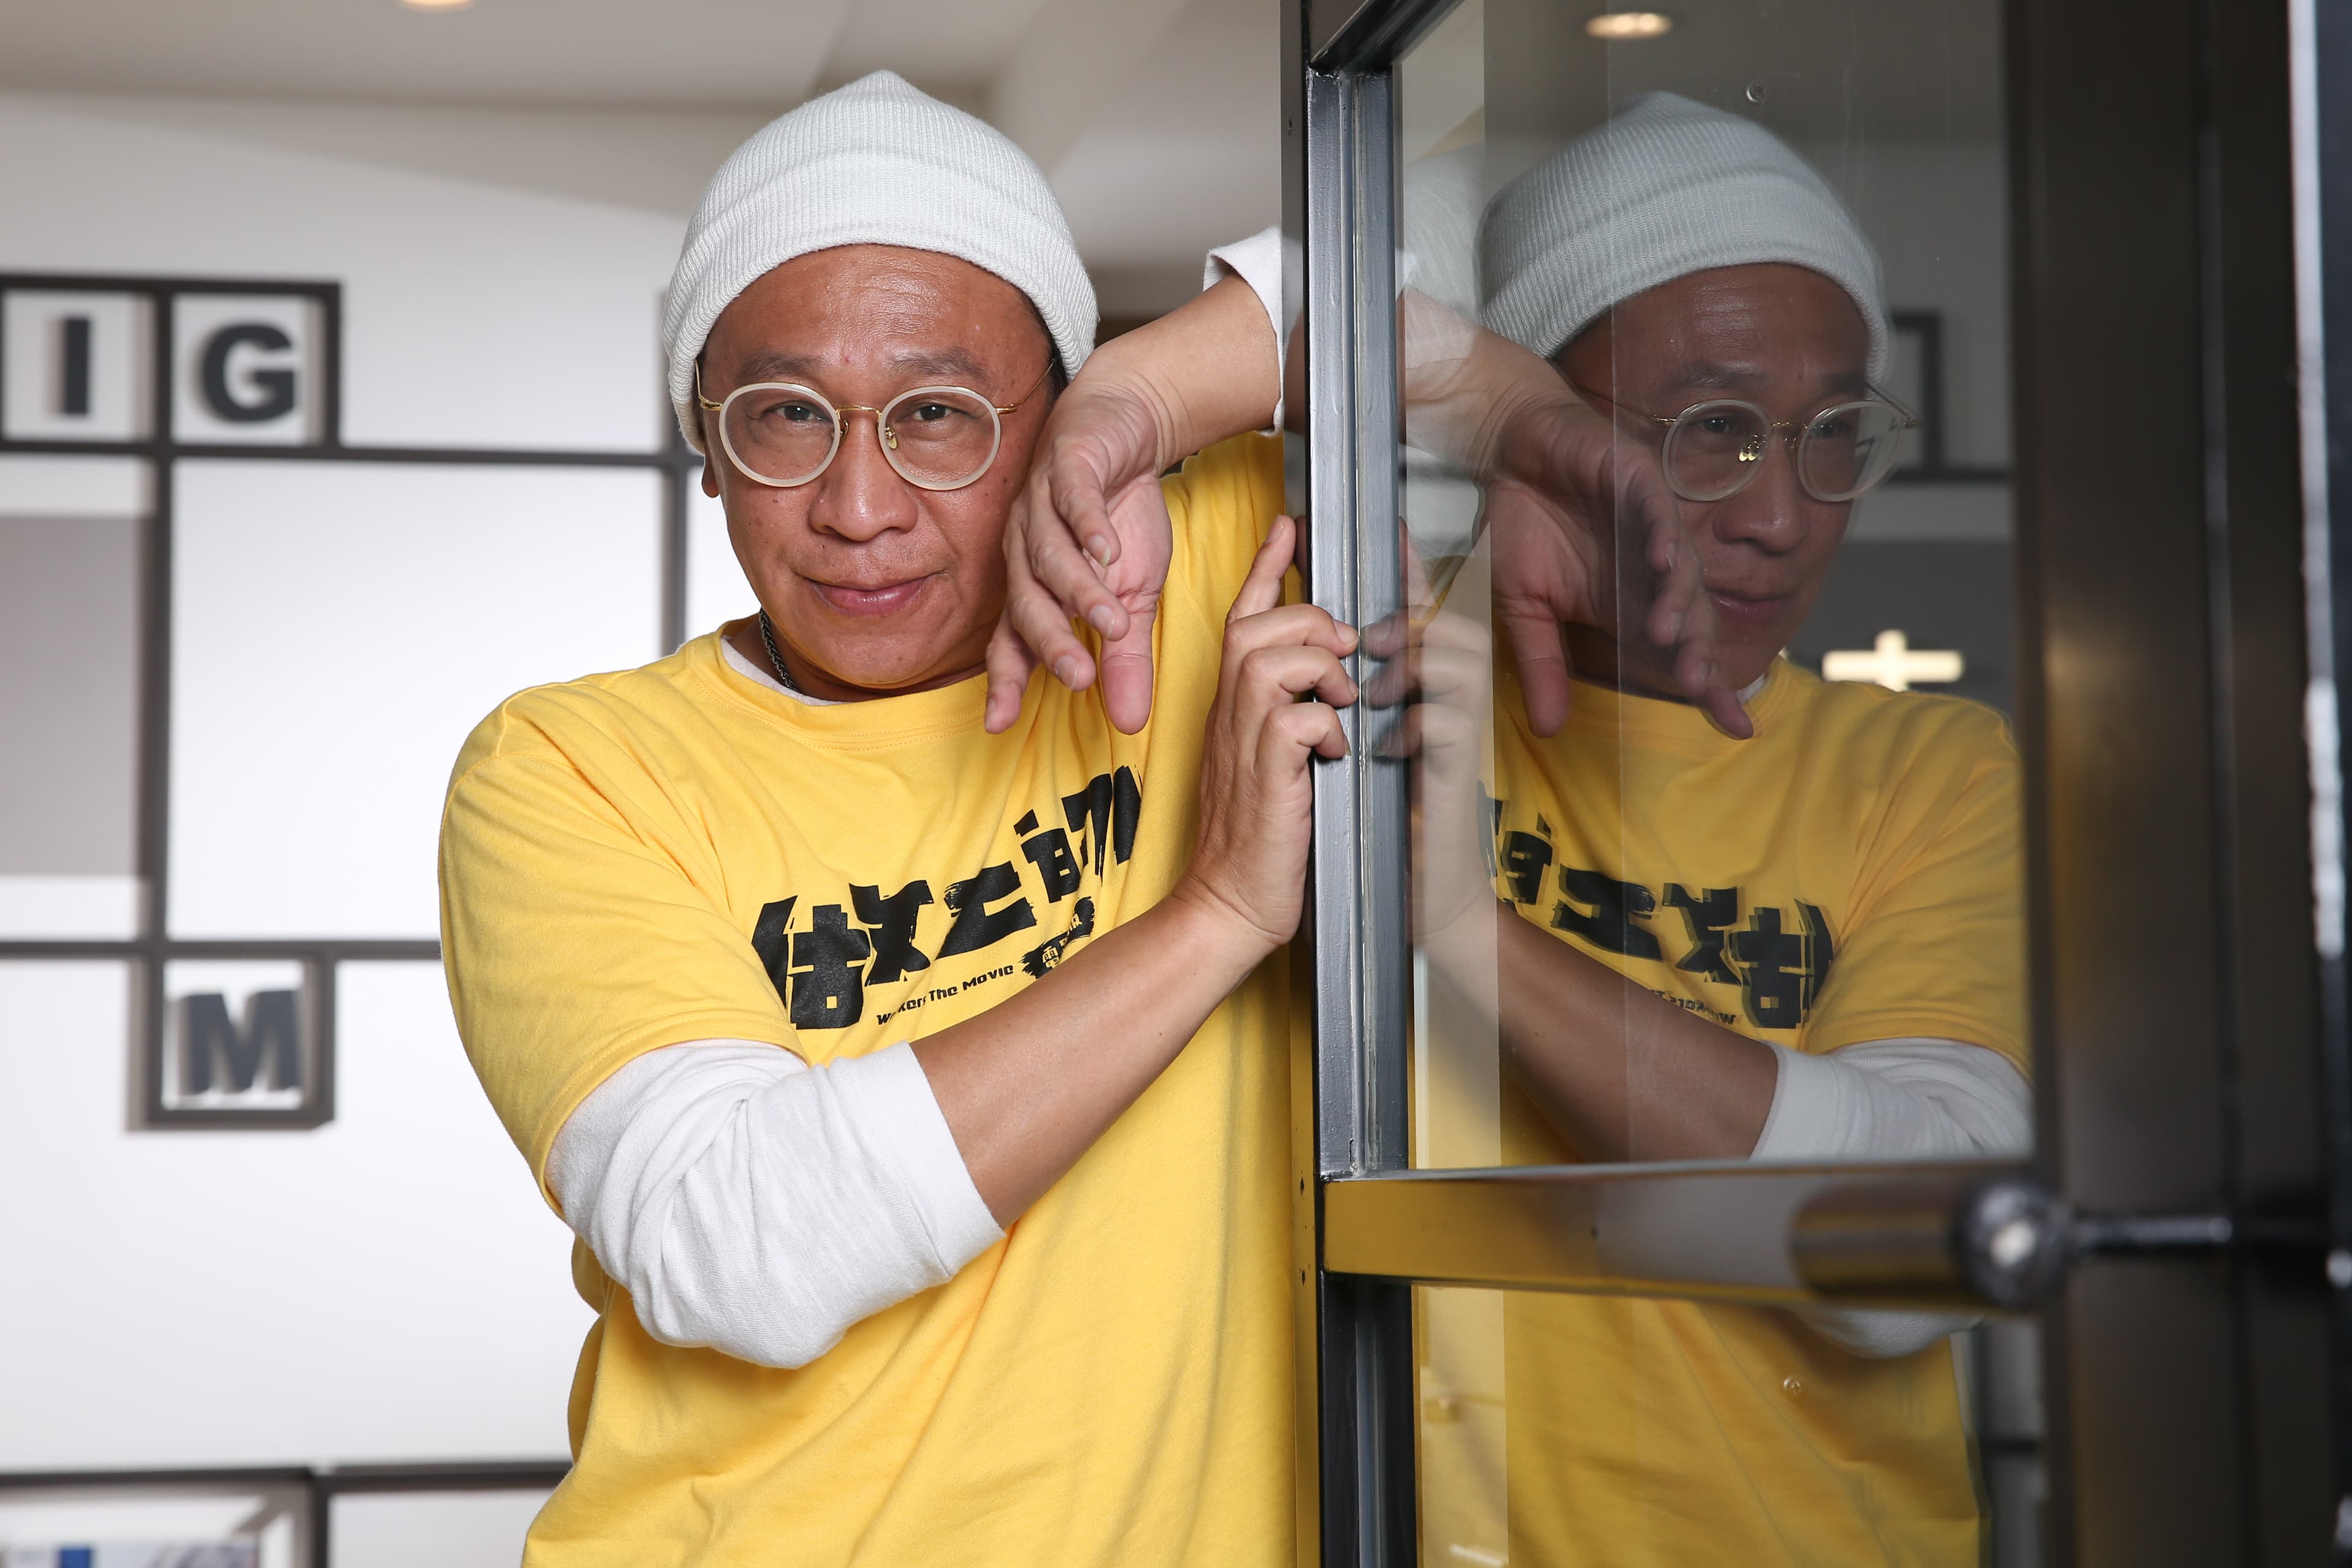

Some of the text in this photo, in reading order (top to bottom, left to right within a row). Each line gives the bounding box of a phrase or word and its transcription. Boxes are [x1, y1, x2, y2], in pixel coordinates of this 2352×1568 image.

[876, 965, 1014, 1025] Wkers The Movie
[186, 988, 303, 1094] M
